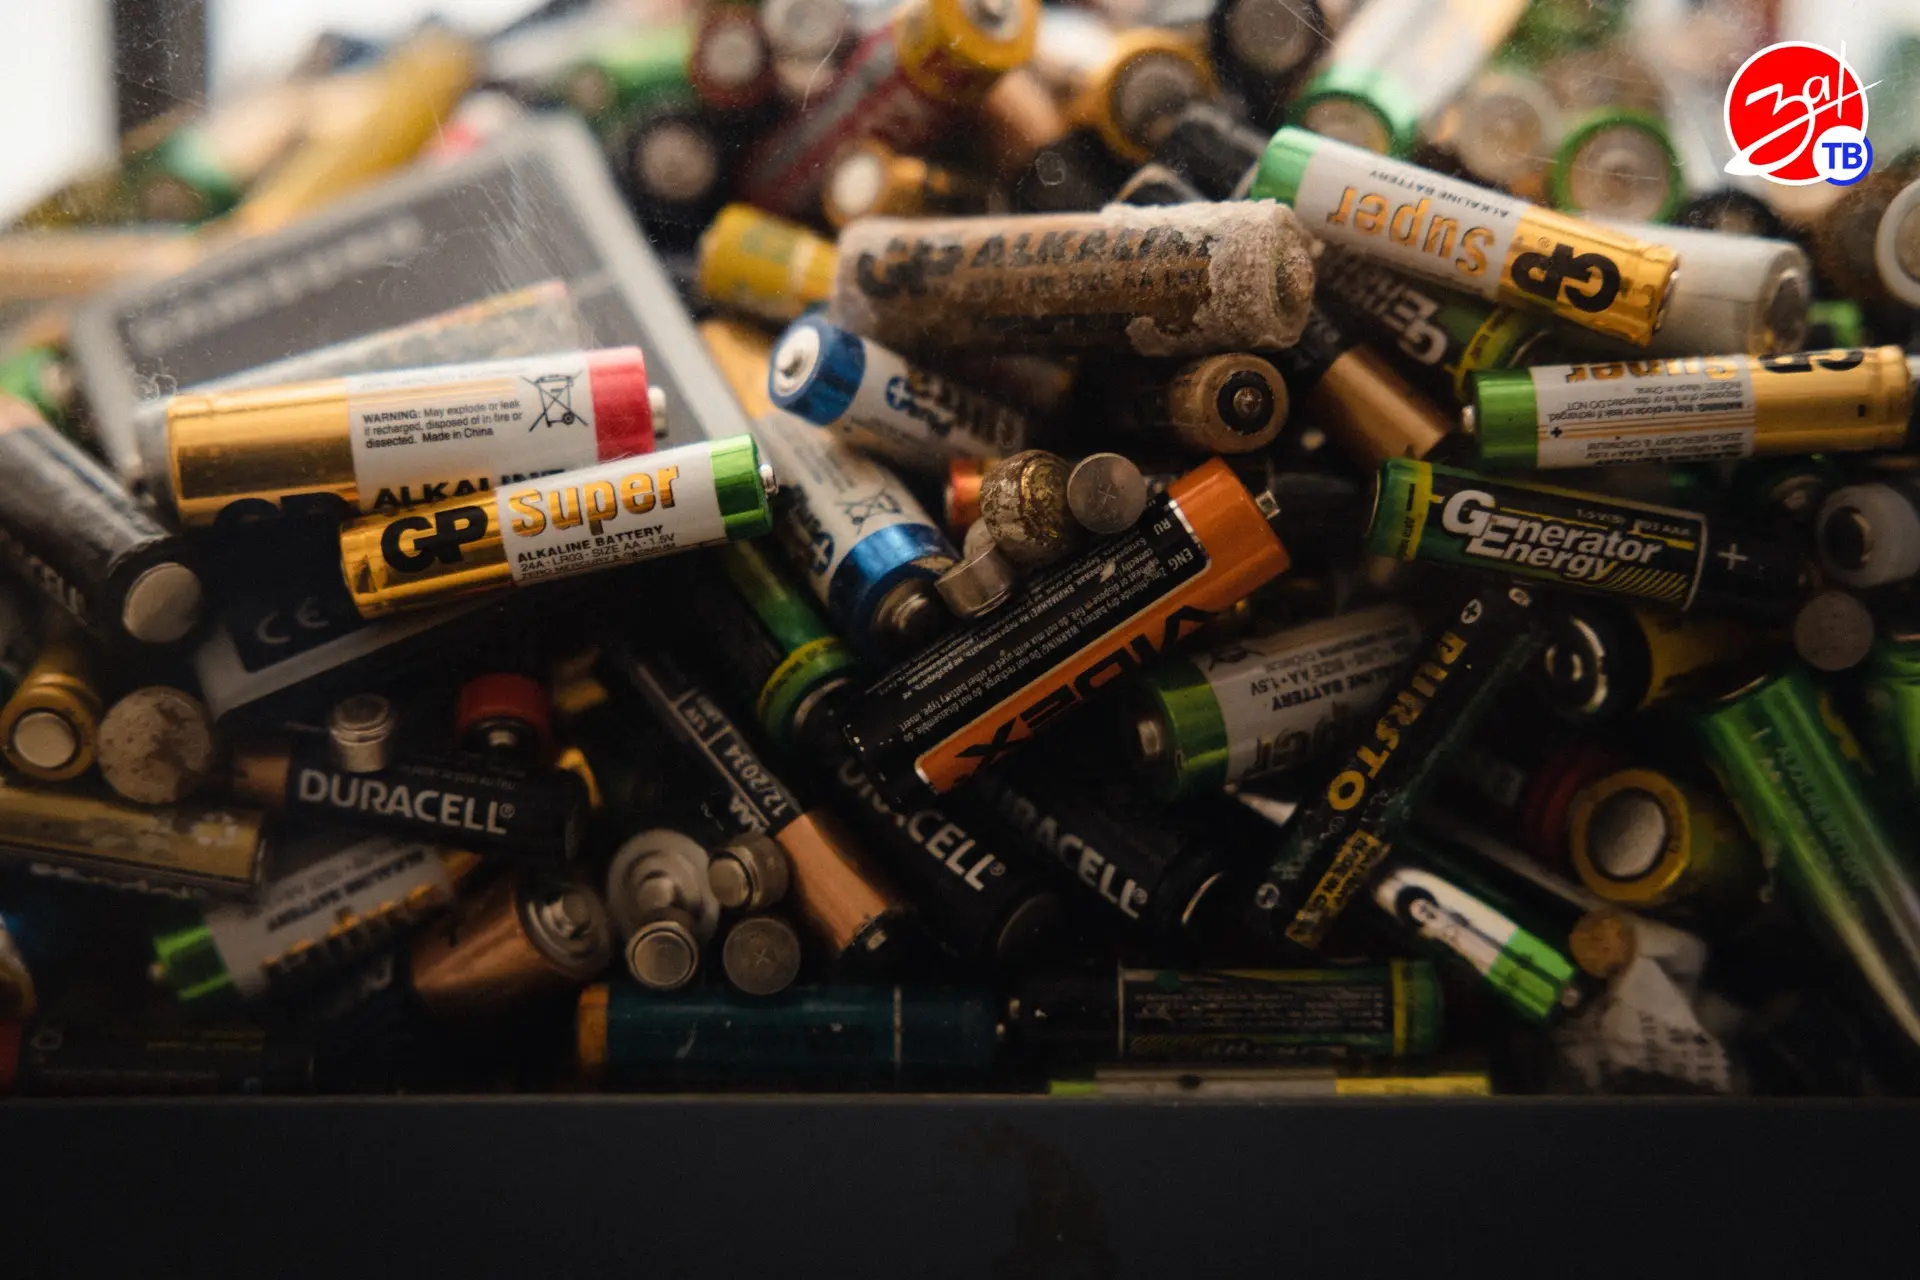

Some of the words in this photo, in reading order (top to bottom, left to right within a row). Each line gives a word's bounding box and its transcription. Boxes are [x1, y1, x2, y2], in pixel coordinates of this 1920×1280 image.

[1366, 166, 1436, 197] BATTERY
[1326, 185, 1496, 279] Super
[1510, 243, 1622, 313] GP
[362, 406, 421, 425] WARNING:
[422, 404, 445, 420] May
[446, 400, 486, 417] explode
[487, 402, 500, 410] or
[371, 419, 424, 438] recharged,
[424, 413, 470, 432] disposed
[492, 410, 510, 422] fire
[365, 432, 417, 450] dissected.
[421, 429, 451, 443] Made
[452, 428, 462, 439] in
[463, 424, 495, 439] China
[508, 465, 680, 538] Super
[1150, 516, 1172, 537] RU
[380, 505, 489, 574] GP
[516, 537, 591, 565] ALKALINE
[594, 523, 664, 547] BATTERY
[520, 558, 544, 573] 24A
[590, 542, 620, 558] SIZE
[621, 538, 641, 552] AA
[1165, 545, 1195, 572] ENG
[1089, 581, 1122, 608] dispose
[1102, 593, 1122, 613] dry
[1043, 621, 1060, 637] not
[1056, 615, 1070, 629] do
[1010, 639, 1032, 658] with
[1028, 630, 1047, 647] mix
[993, 651, 1015, 670] used
[1013, 655, 1031, 671] not
[1026, 648, 1042, 663] Do
[964, 668, 989, 688] other
[936, 679, 969, 706] battery
[956, 692, 974, 708] not
[969, 685, 984, 700] do
[895, 711, 923, 734] insert
[1328, 631, 1467, 811] PURSTO
[900, 729, 916, 744] do
[720, 734, 793, 822] 12/2034
